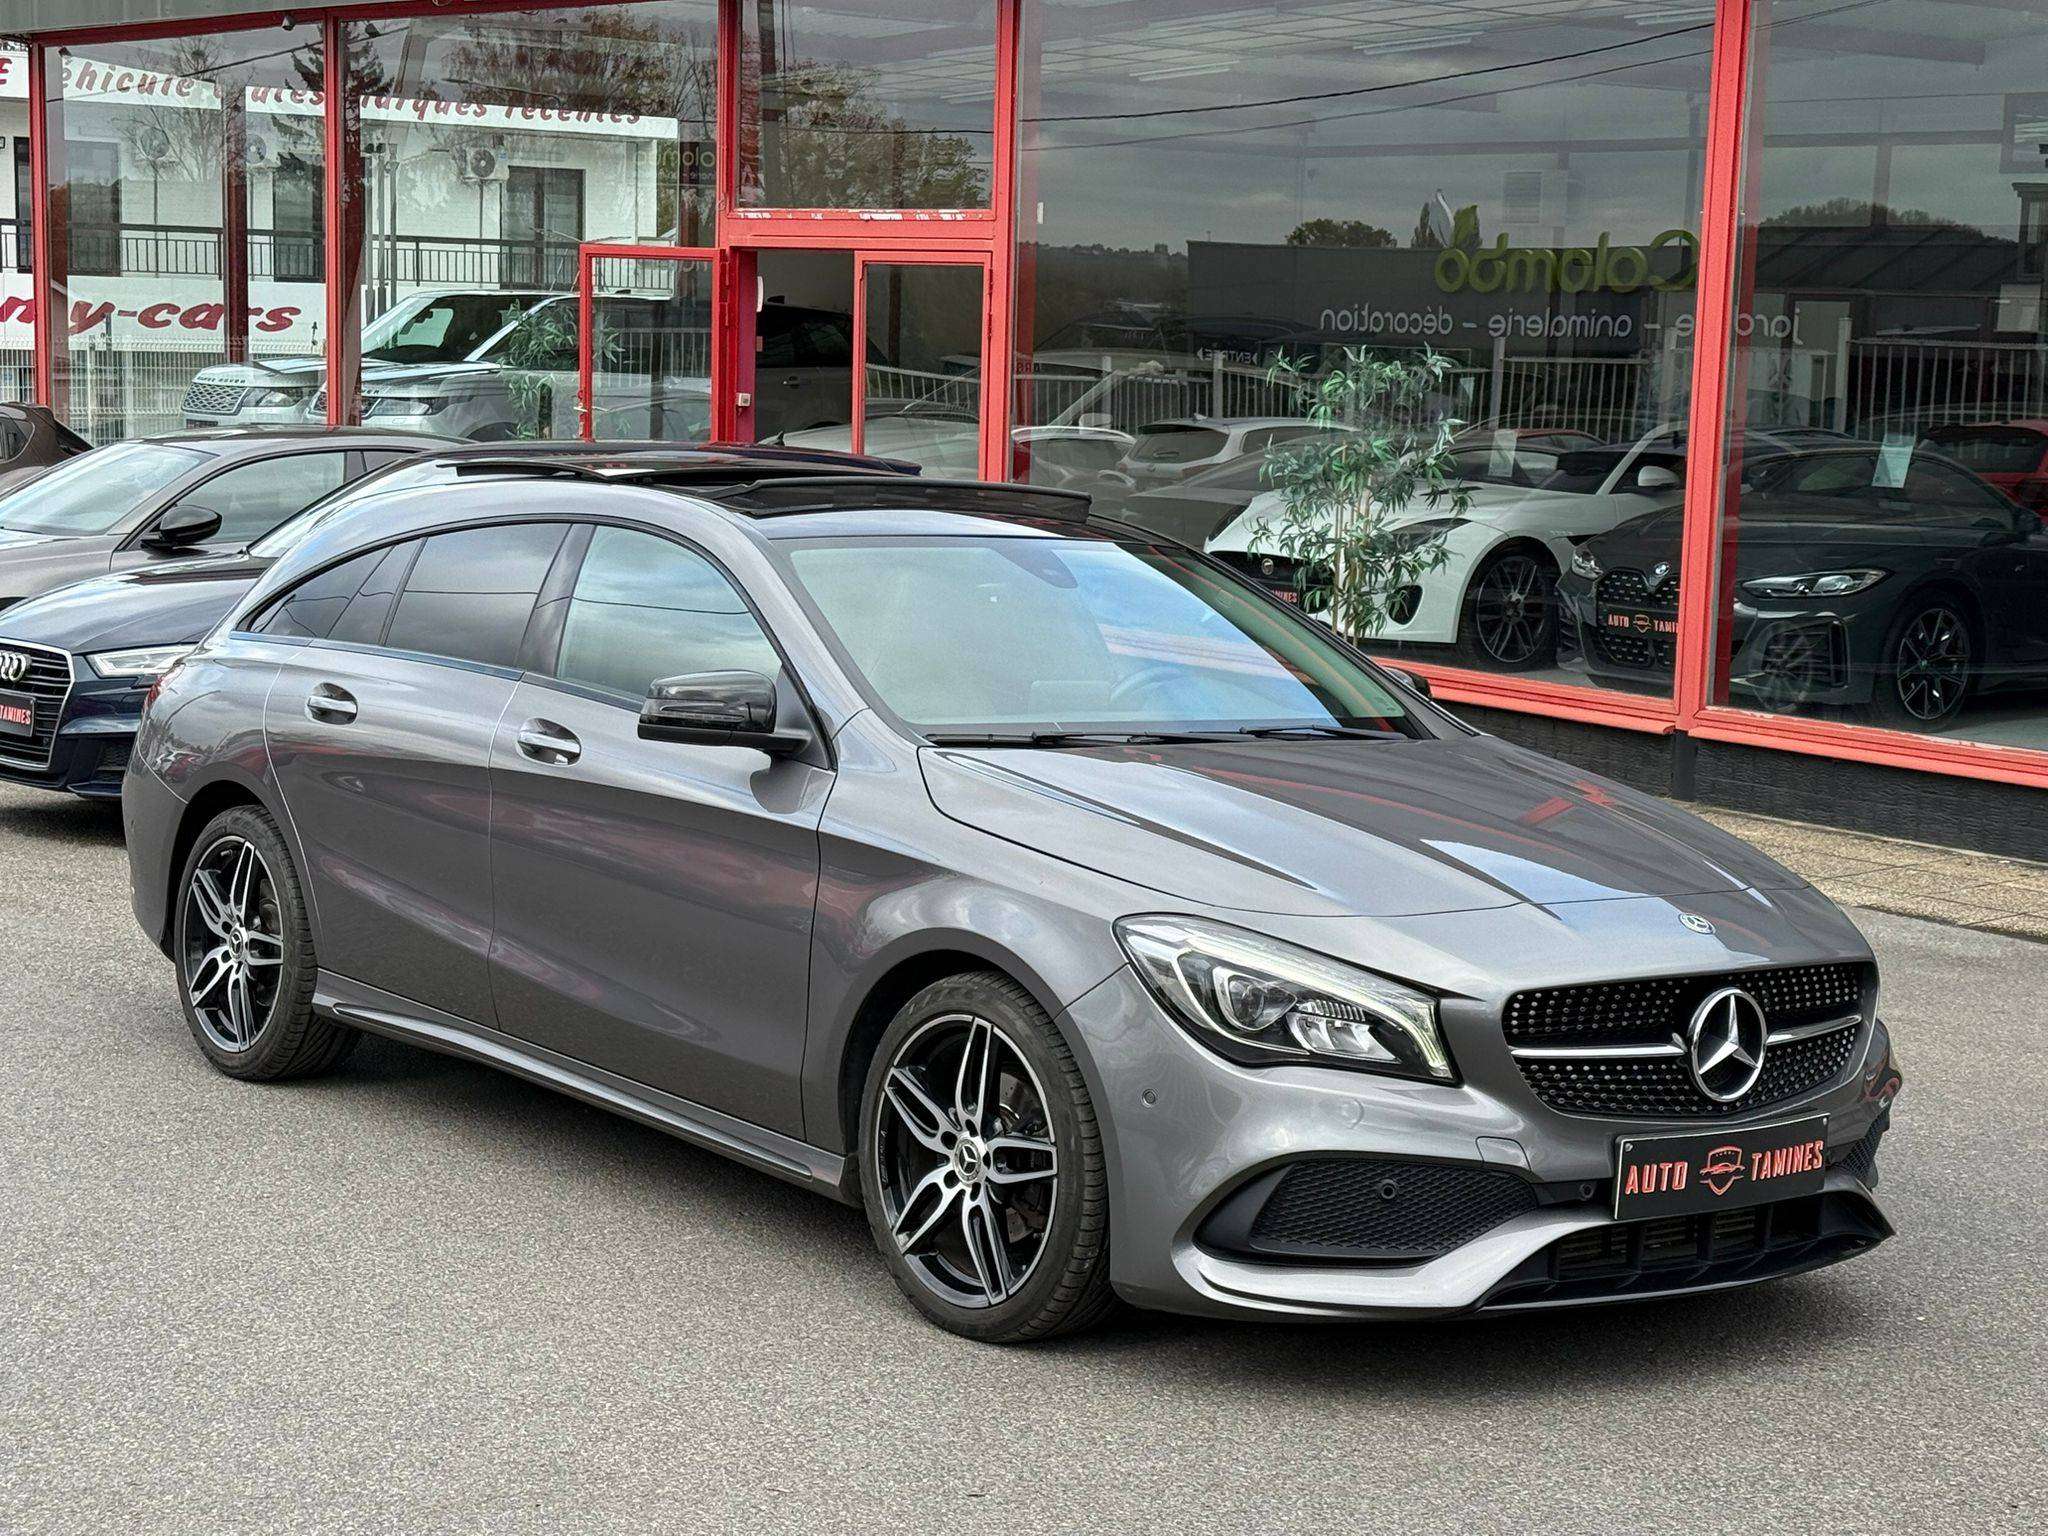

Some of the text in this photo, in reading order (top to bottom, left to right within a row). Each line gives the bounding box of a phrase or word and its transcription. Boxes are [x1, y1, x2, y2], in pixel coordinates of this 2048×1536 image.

[1608, 614, 1630, 628] AUTO
[1625, 1140, 1825, 1195] AUTO TAMINES
